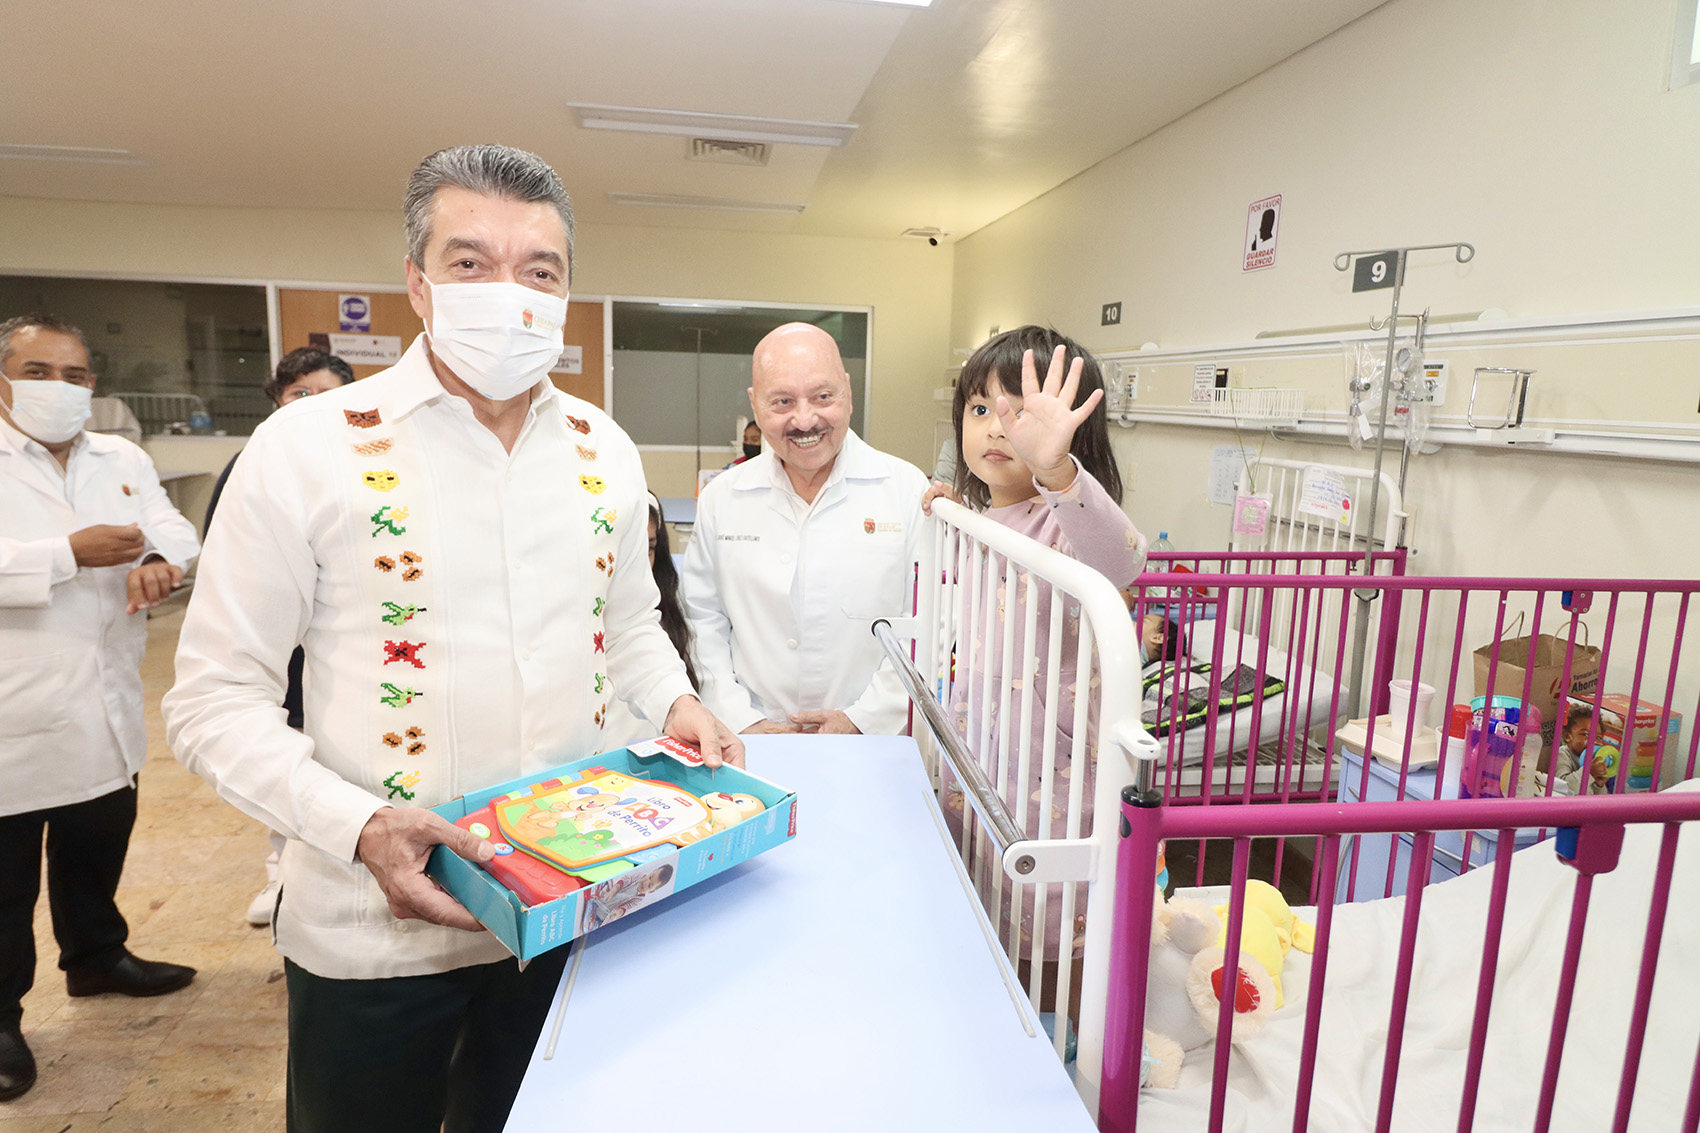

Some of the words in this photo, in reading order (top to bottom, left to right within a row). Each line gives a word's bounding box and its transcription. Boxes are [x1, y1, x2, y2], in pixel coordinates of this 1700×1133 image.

[1251, 204, 1262, 213] POR
[1262, 198, 1281, 210] FAVOR
[1246, 248, 1274, 260] GUARDAR
[1246, 256, 1273, 268] SILENCIO
[1371, 260, 1387, 283] 9
[1105, 306, 1118, 321] 10
[647, 797, 671, 810] Libro
[619, 814, 652, 838] Perrito
